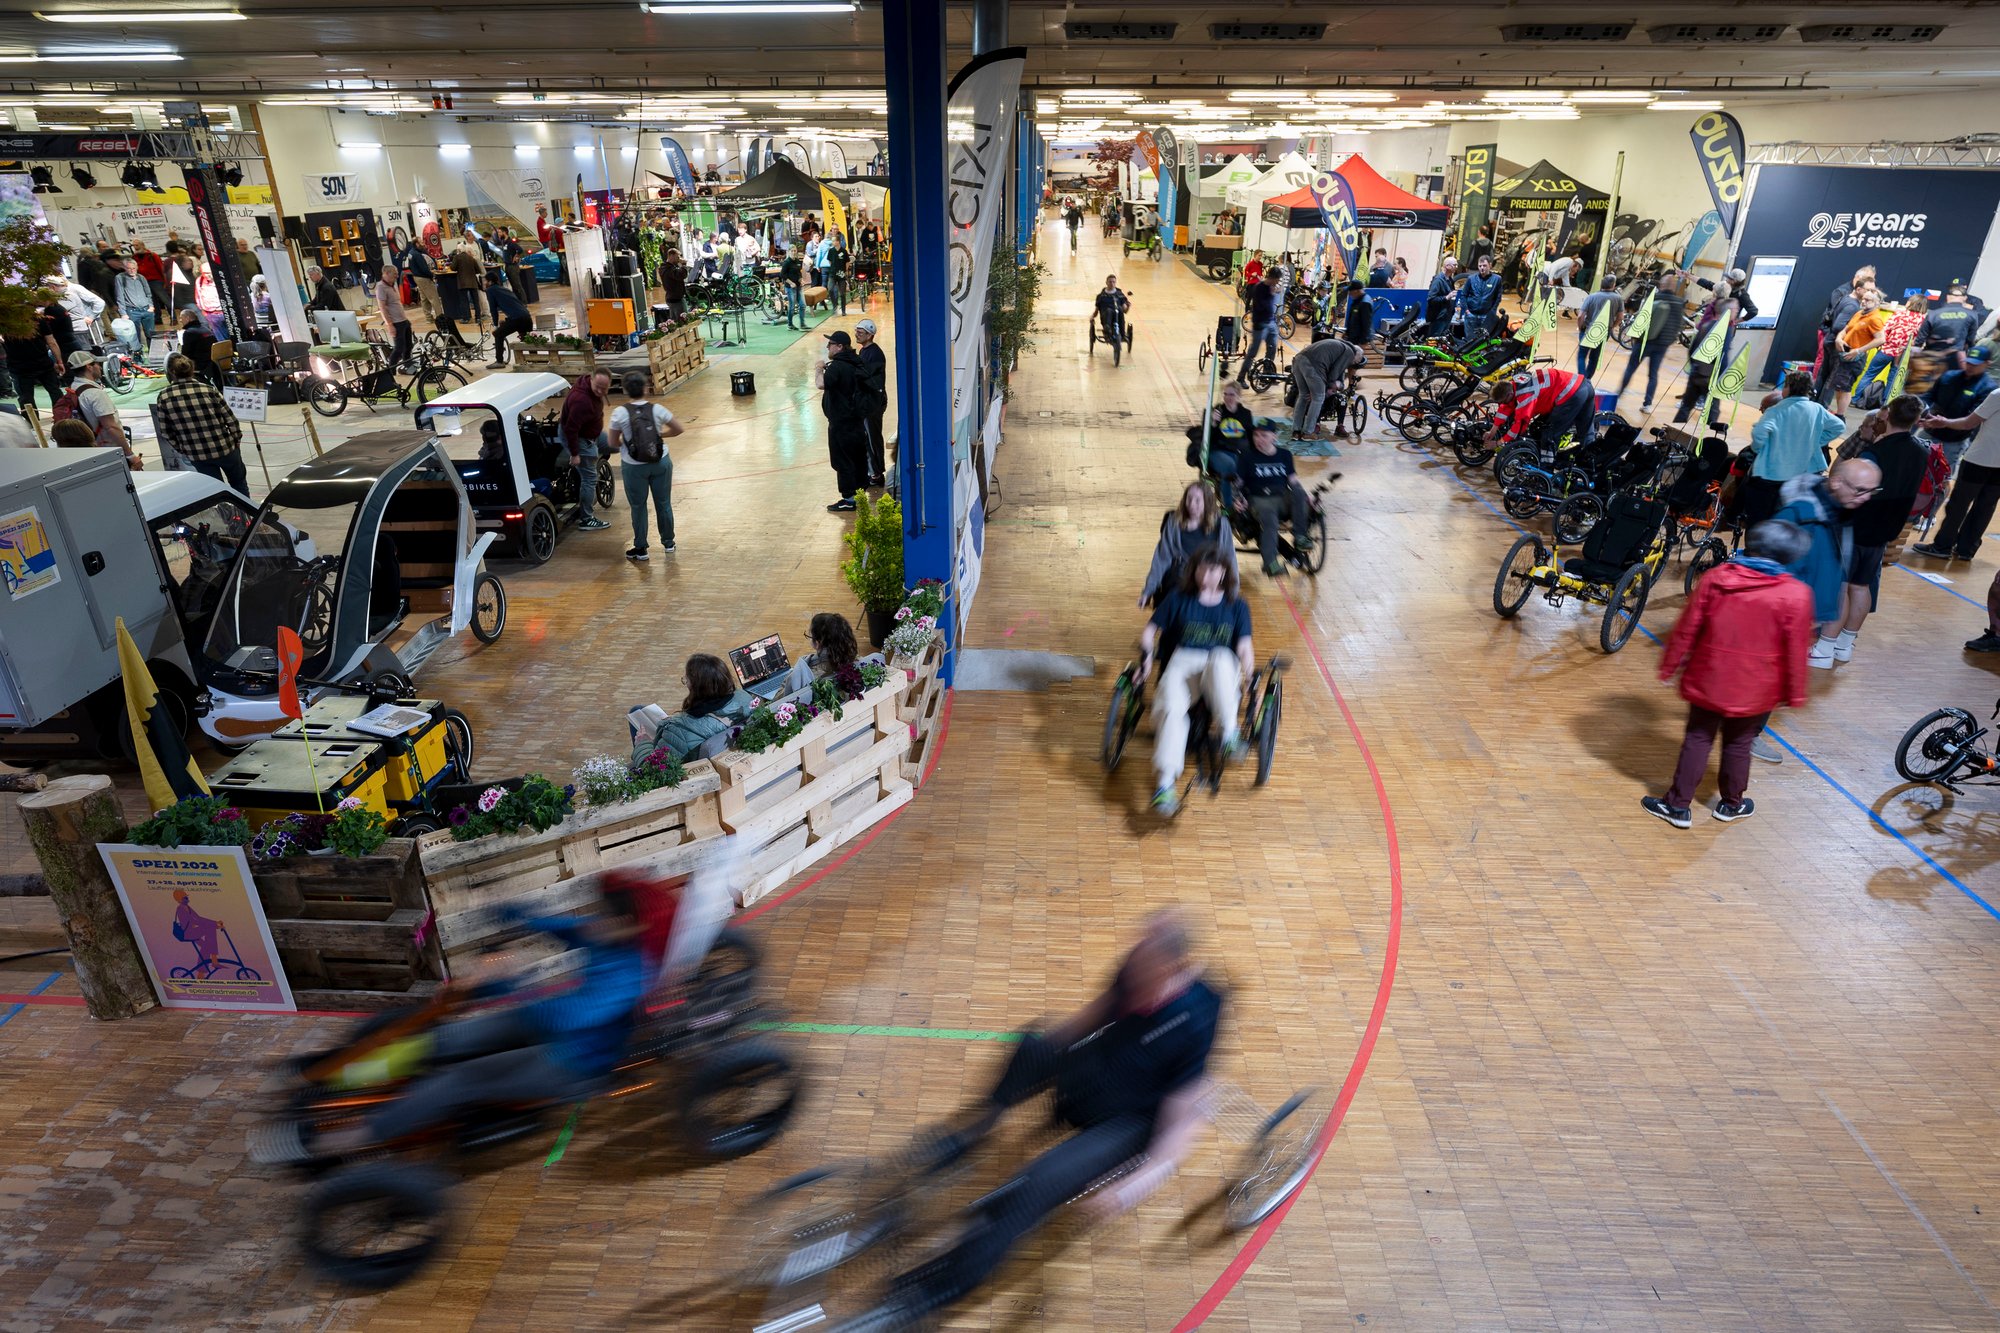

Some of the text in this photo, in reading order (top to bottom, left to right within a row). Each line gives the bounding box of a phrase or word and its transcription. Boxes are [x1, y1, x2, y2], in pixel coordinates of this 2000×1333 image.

[79, 141, 136, 150] REBEL
[949, 121, 992, 231] CIXI
[1463, 149, 1488, 196] X10
[321, 176, 347, 196] SON
[1530, 179, 1578, 192] X10
[1510, 199, 1551, 209] PREMIUM
[1554, 199, 1569, 209] BIK
[198, 205, 216, 261] REBEL
[1802, 212, 1927, 249] 25 years
[1847, 233, 1919, 249] of stories
[132, 859, 219, 870] SPEZI 2024
